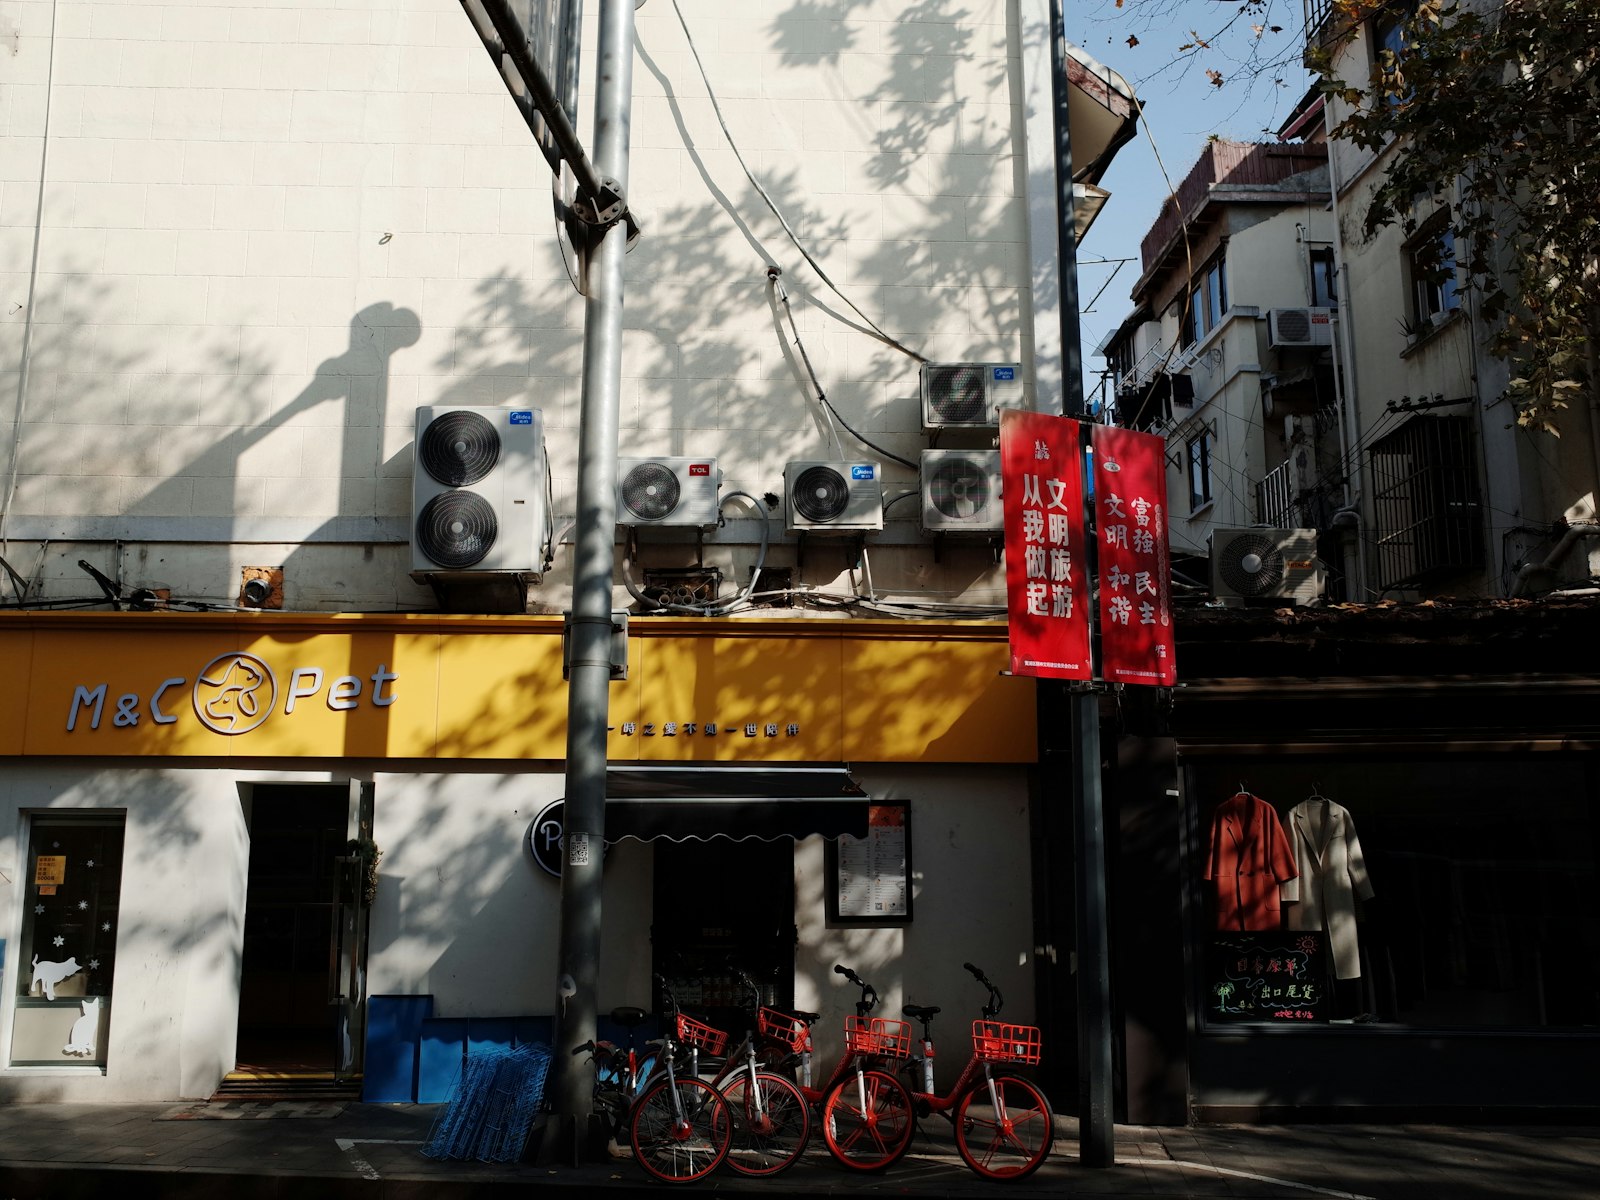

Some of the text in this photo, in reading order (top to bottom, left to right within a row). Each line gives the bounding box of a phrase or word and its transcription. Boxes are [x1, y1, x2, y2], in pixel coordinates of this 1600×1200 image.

[1022, 474, 1050, 617] 从我做起
[1046, 478, 1074, 619] 文明旅游
[1104, 493, 1129, 550] 文明
[1107, 565, 1133, 626] 和谐
[1135, 571, 1157, 625] 民主
[284, 664, 399, 715] Pet
[1260, 984, 1315, 1000] 出口尾货
